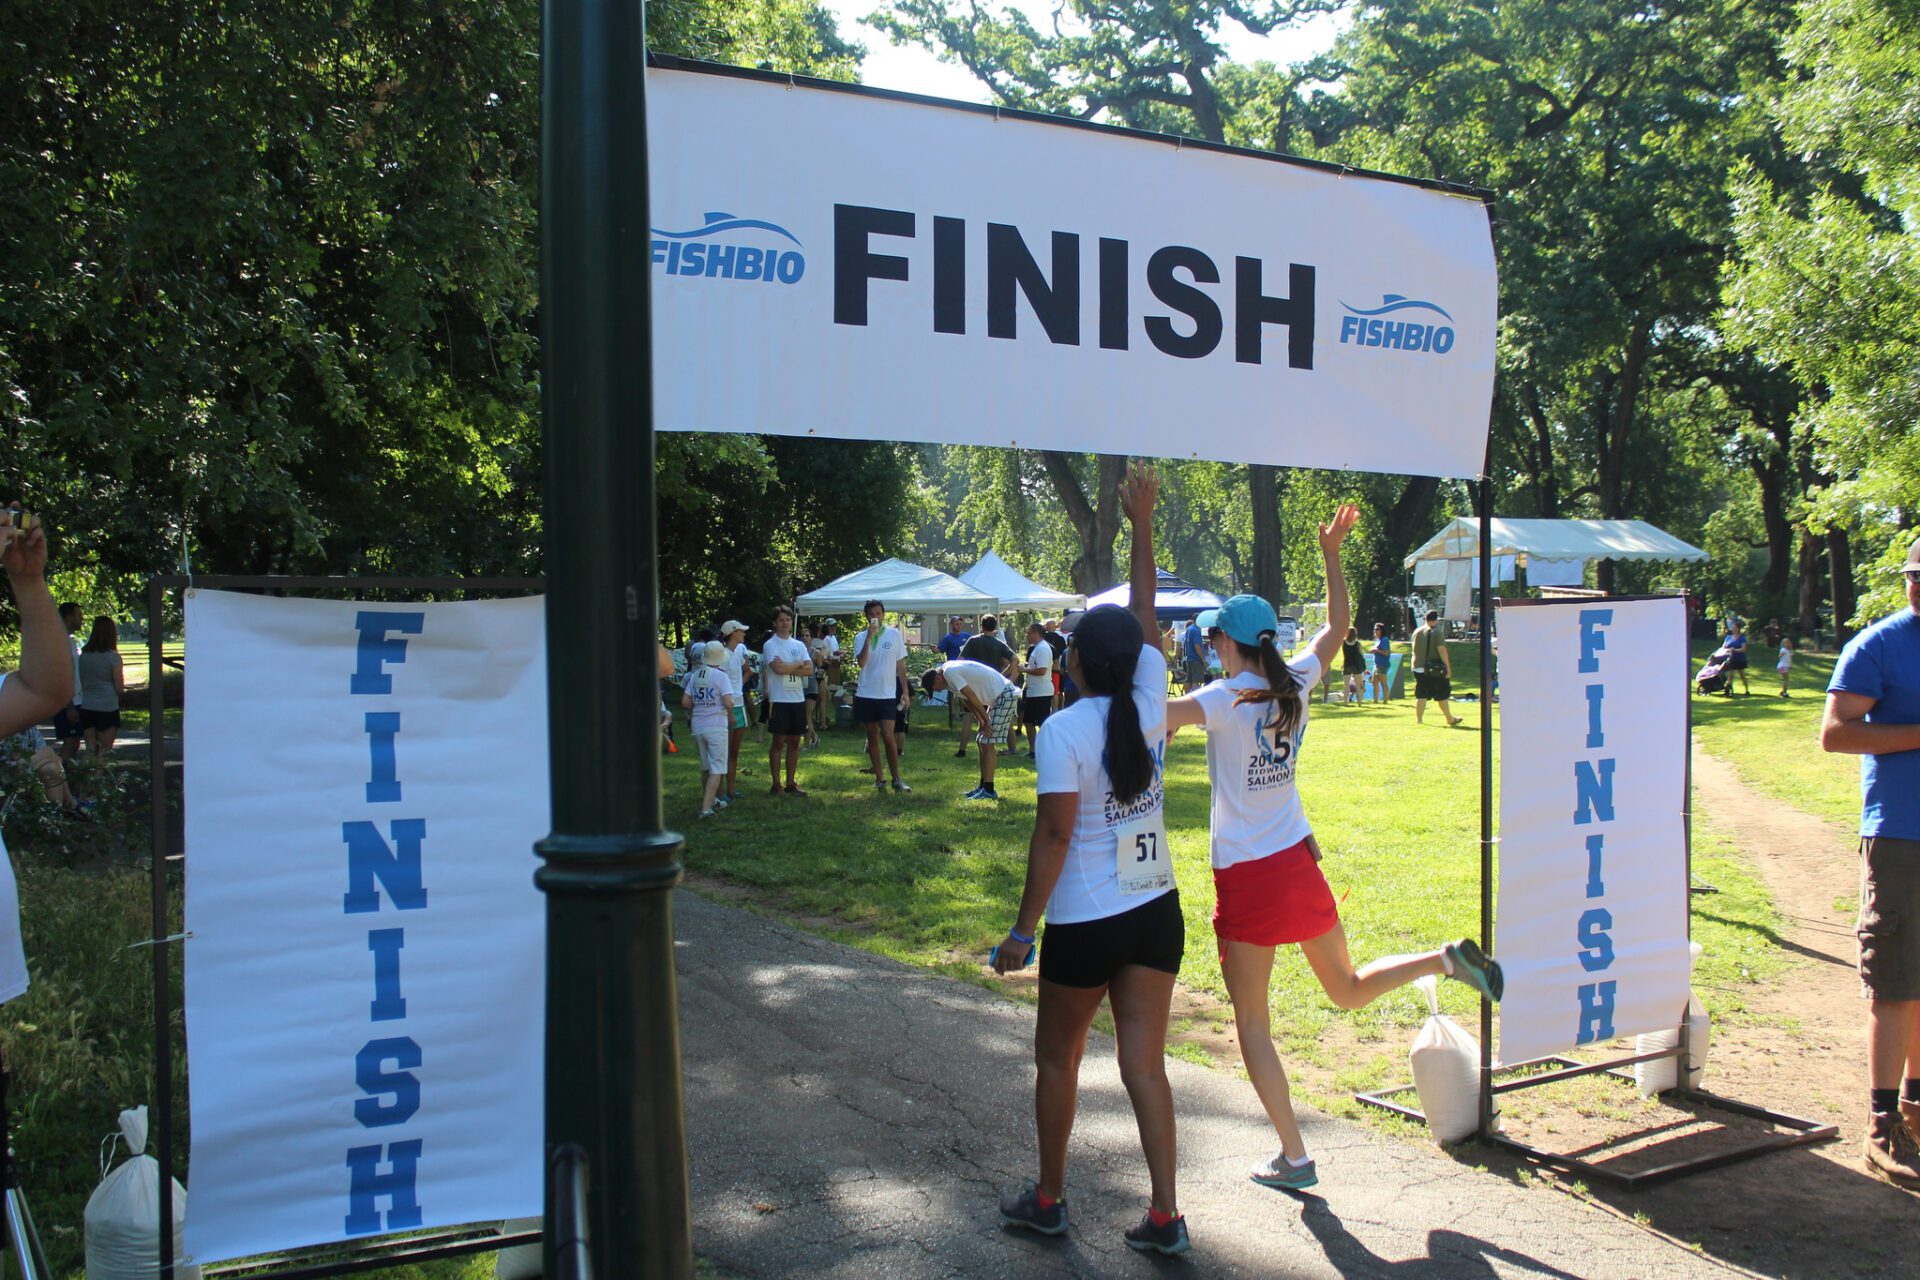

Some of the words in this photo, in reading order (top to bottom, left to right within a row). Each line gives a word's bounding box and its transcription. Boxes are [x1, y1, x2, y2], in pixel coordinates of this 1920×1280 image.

[650, 240, 805, 284] FISHBIO
[834, 203, 1316, 371] FINISH
[1340, 315, 1455, 354] FISHBIO
[699, 687, 715, 700] 5K
[1247, 769, 1290, 787] SALMON
[1105, 798, 1154, 824] SALMON
[1575, 608, 1617, 1046] FINISH
[1135, 832, 1157, 862] 57
[343, 610, 428, 1235] FINISH
